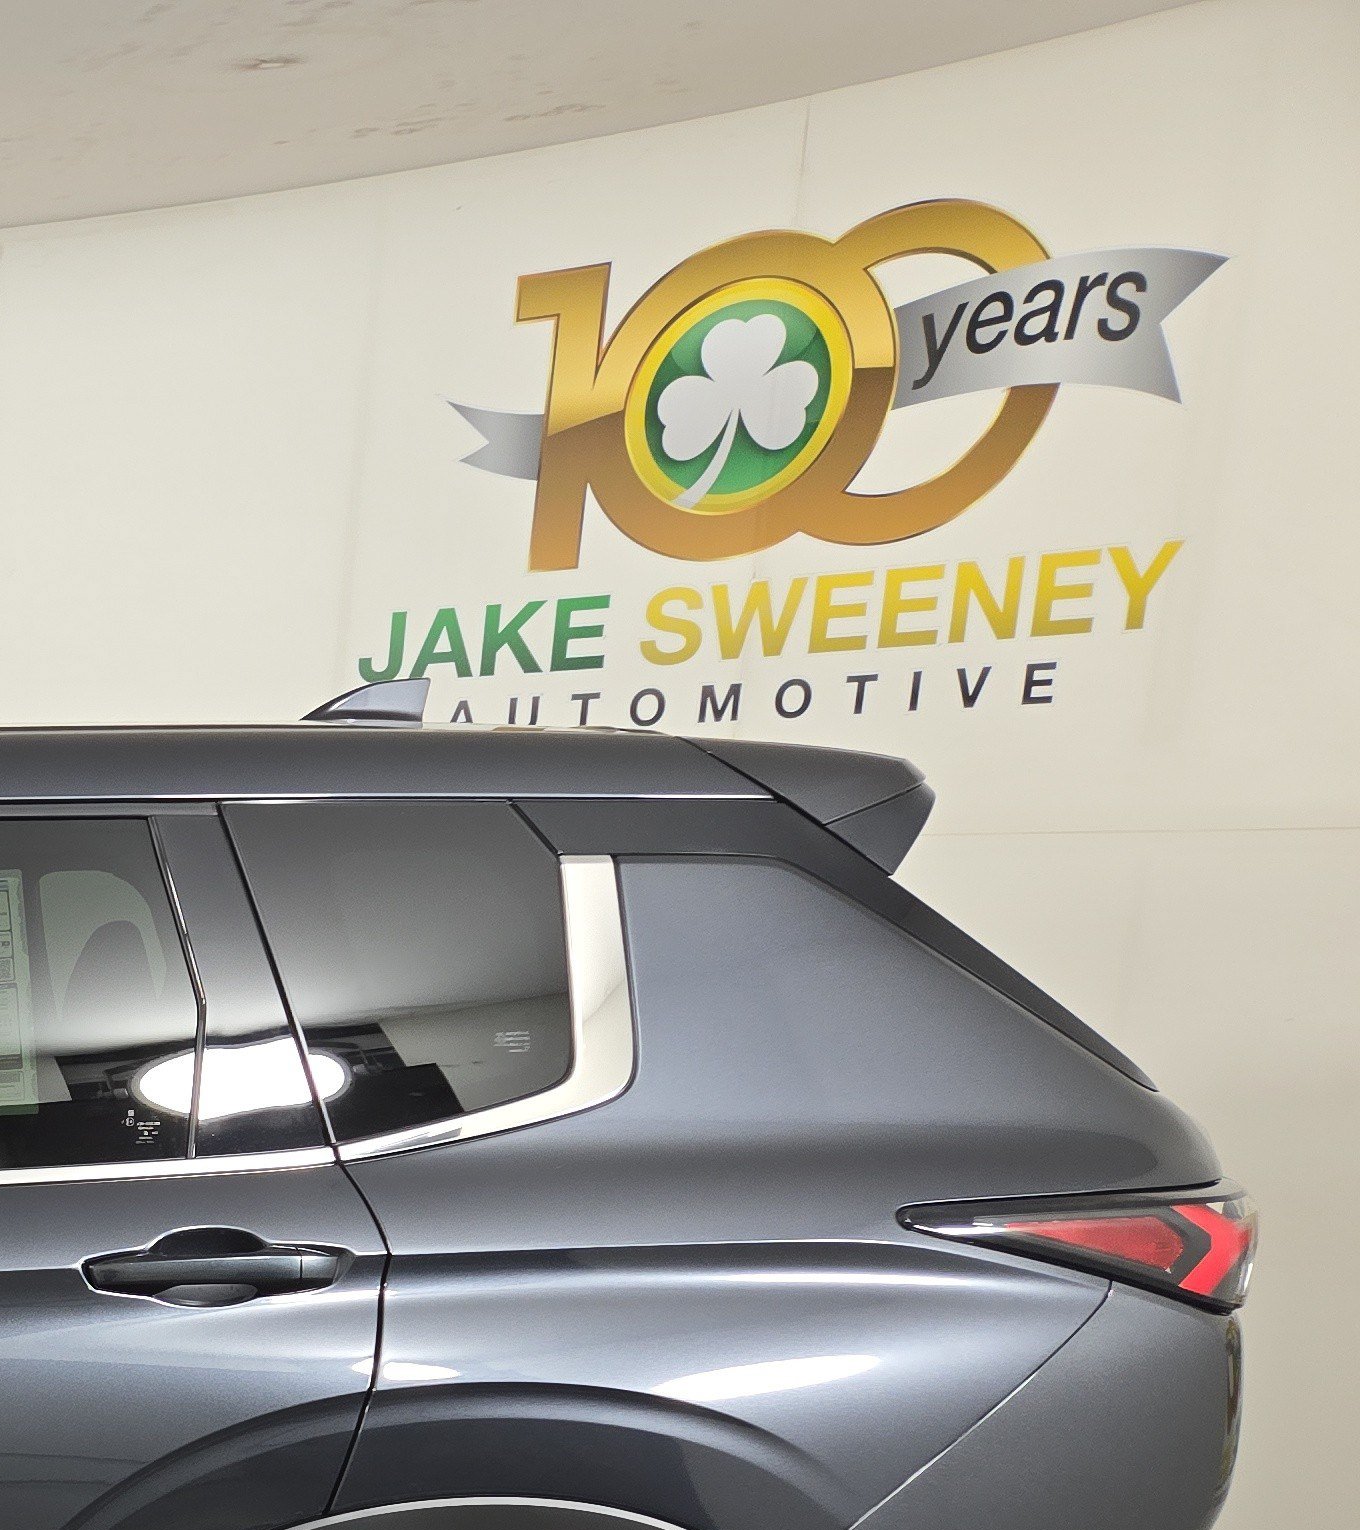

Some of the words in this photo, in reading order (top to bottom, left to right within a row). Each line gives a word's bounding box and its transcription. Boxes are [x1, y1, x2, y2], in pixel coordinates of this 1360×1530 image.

[514, 199, 1060, 573] 100
[911, 267, 1148, 391] years
[357, 594, 612, 684] JAKE
[639, 540, 1186, 667] SWEENEY
[448, 661, 1060, 728] AUTOMOTIVE
